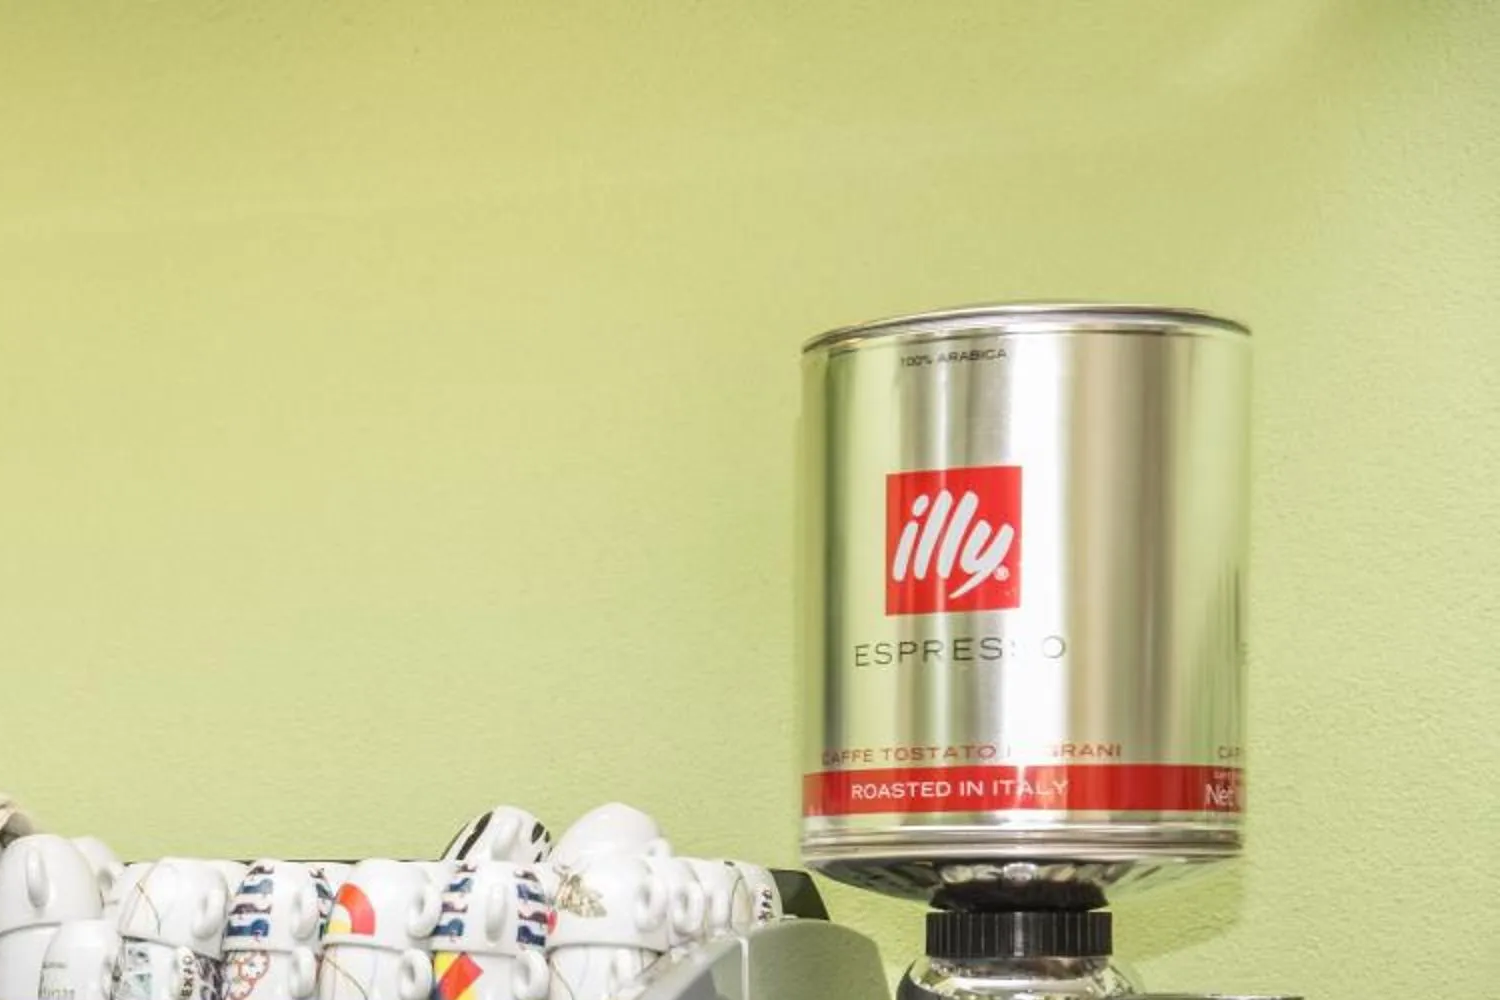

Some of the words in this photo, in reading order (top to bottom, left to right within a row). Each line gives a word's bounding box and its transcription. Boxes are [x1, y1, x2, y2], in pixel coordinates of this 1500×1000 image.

[937, 348, 1007, 362] ARABICA
[855, 636, 1067, 667] ESPRESO
[880, 745, 997, 762] TOSTATO
[851, 781, 951, 800] ROASTED
[960, 780, 985, 797] IN
[993, 779, 1069, 796] ITALY
